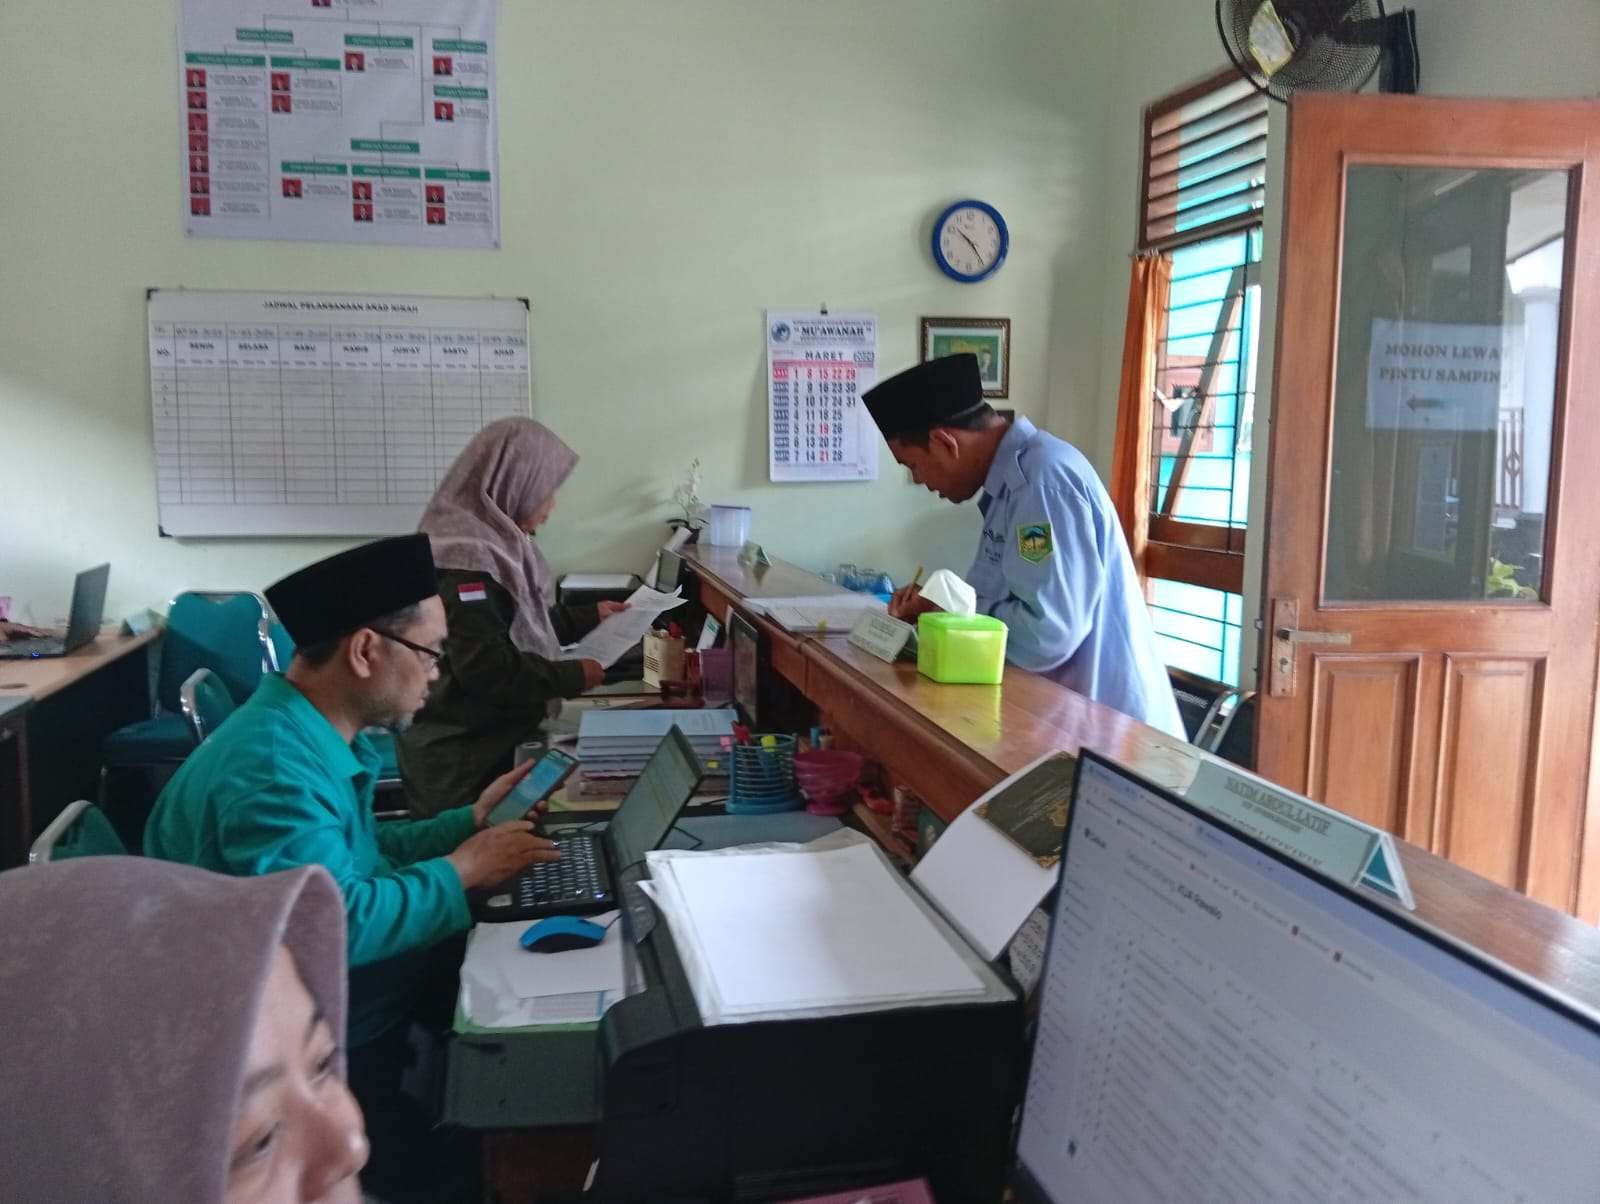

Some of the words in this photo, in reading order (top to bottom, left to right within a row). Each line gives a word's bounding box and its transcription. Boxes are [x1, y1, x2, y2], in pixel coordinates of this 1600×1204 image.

[804, 351, 843, 360] MARET
[1384, 343, 1448, 359] MOHON
[1379, 366, 1432, 383] PINTU
[1435, 368, 1508, 383] SAMPIN
